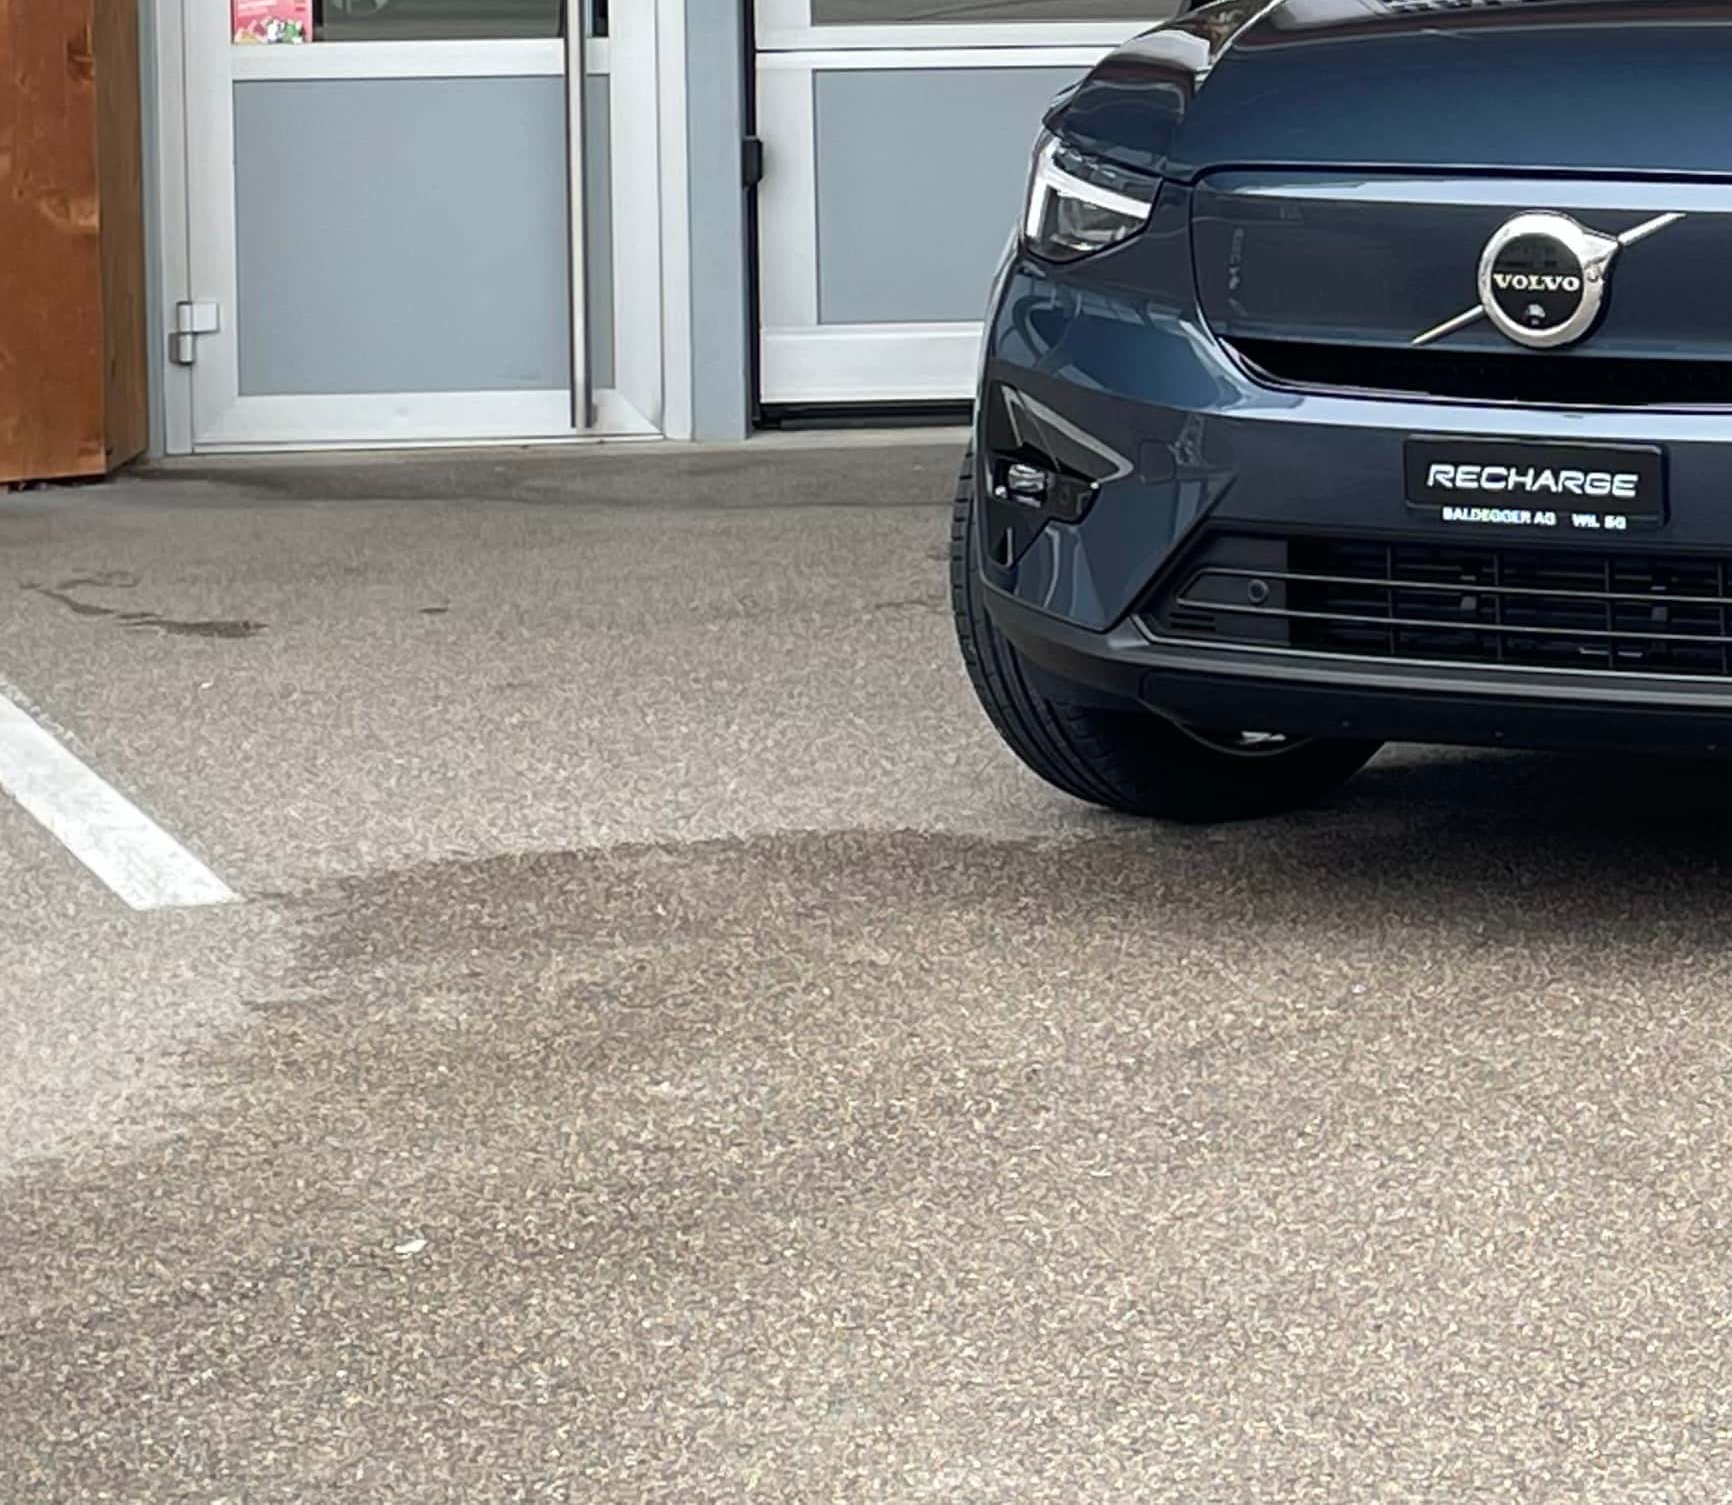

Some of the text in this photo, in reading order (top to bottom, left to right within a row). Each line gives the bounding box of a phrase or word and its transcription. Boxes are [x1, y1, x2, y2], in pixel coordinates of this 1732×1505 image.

[1492, 272, 1581, 293] VOLVO
[1426, 463, 1639, 498] RECHARGE
[1442, 506, 1532, 524] BALDEGGER
